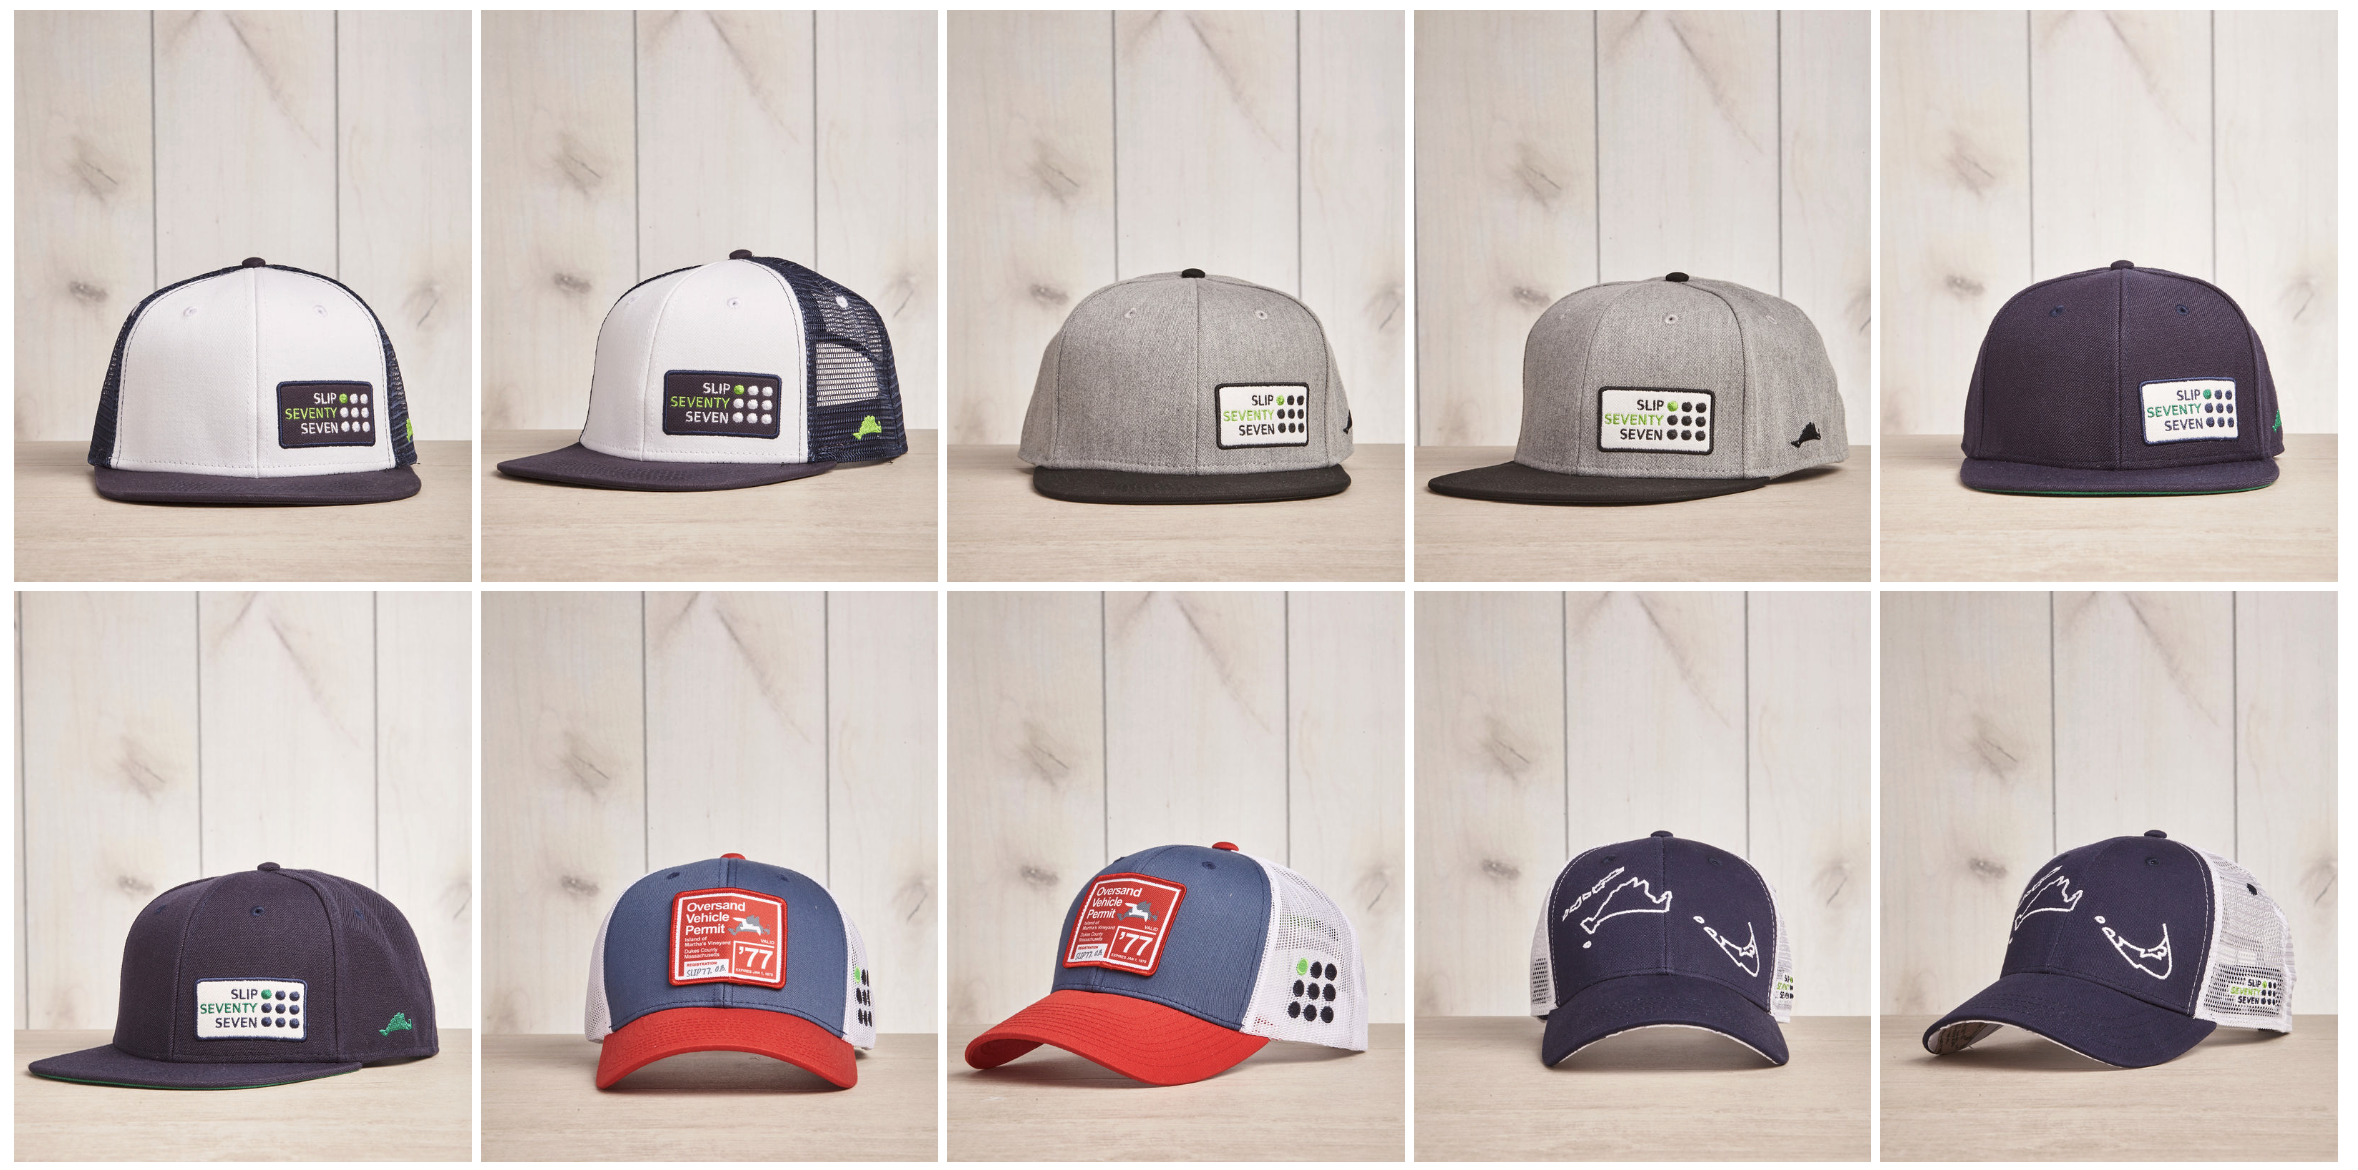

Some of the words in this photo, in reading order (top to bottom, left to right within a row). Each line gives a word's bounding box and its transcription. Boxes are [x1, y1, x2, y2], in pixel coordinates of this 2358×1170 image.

[702, 382, 731, 395] SLIP
[2176, 388, 2201, 401] SLIP
[313, 392, 337, 405] SLIP
[670, 395, 731, 409] SEVENTY
[1251, 394, 1274, 406] SLIP
[1636, 399, 1665, 411] SLIP
[285, 406, 338, 420] SEVENTY
[1222, 408, 1275, 422] SEVENTY
[2146, 402, 2202, 418] SEVENTY
[685, 410, 729, 425] SEVEN
[1604, 413, 1665, 426] SEVENTY
[300, 421, 339, 435] SEVEN
[1238, 423, 1275, 436] SEVEN
[2164, 417, 2204, 432] SEVEN
[1619, 428, 1663, 441] SEVEN
[1096, 886, 1143, 898] Oversand
[686, 901, 746, 912] Oversand
[1092, 896, 1123, 908] Vehicle
[685, 911, 730, 924] Vehicle
[1086, 908, 1116, 919] Permit
[685, 923, 726, 936] Permit
[2247, 978, 2262, 988] SLIP
[230, 988, 259, 1000] SLIP
[2230, 986, 2262, 996] SEVENTY
[2237, 995, 2260, 1005] SEVEN
[200, 1002, 258, 1015] SEVENTY
[215, 1016, 258, 1029] SEVEN
